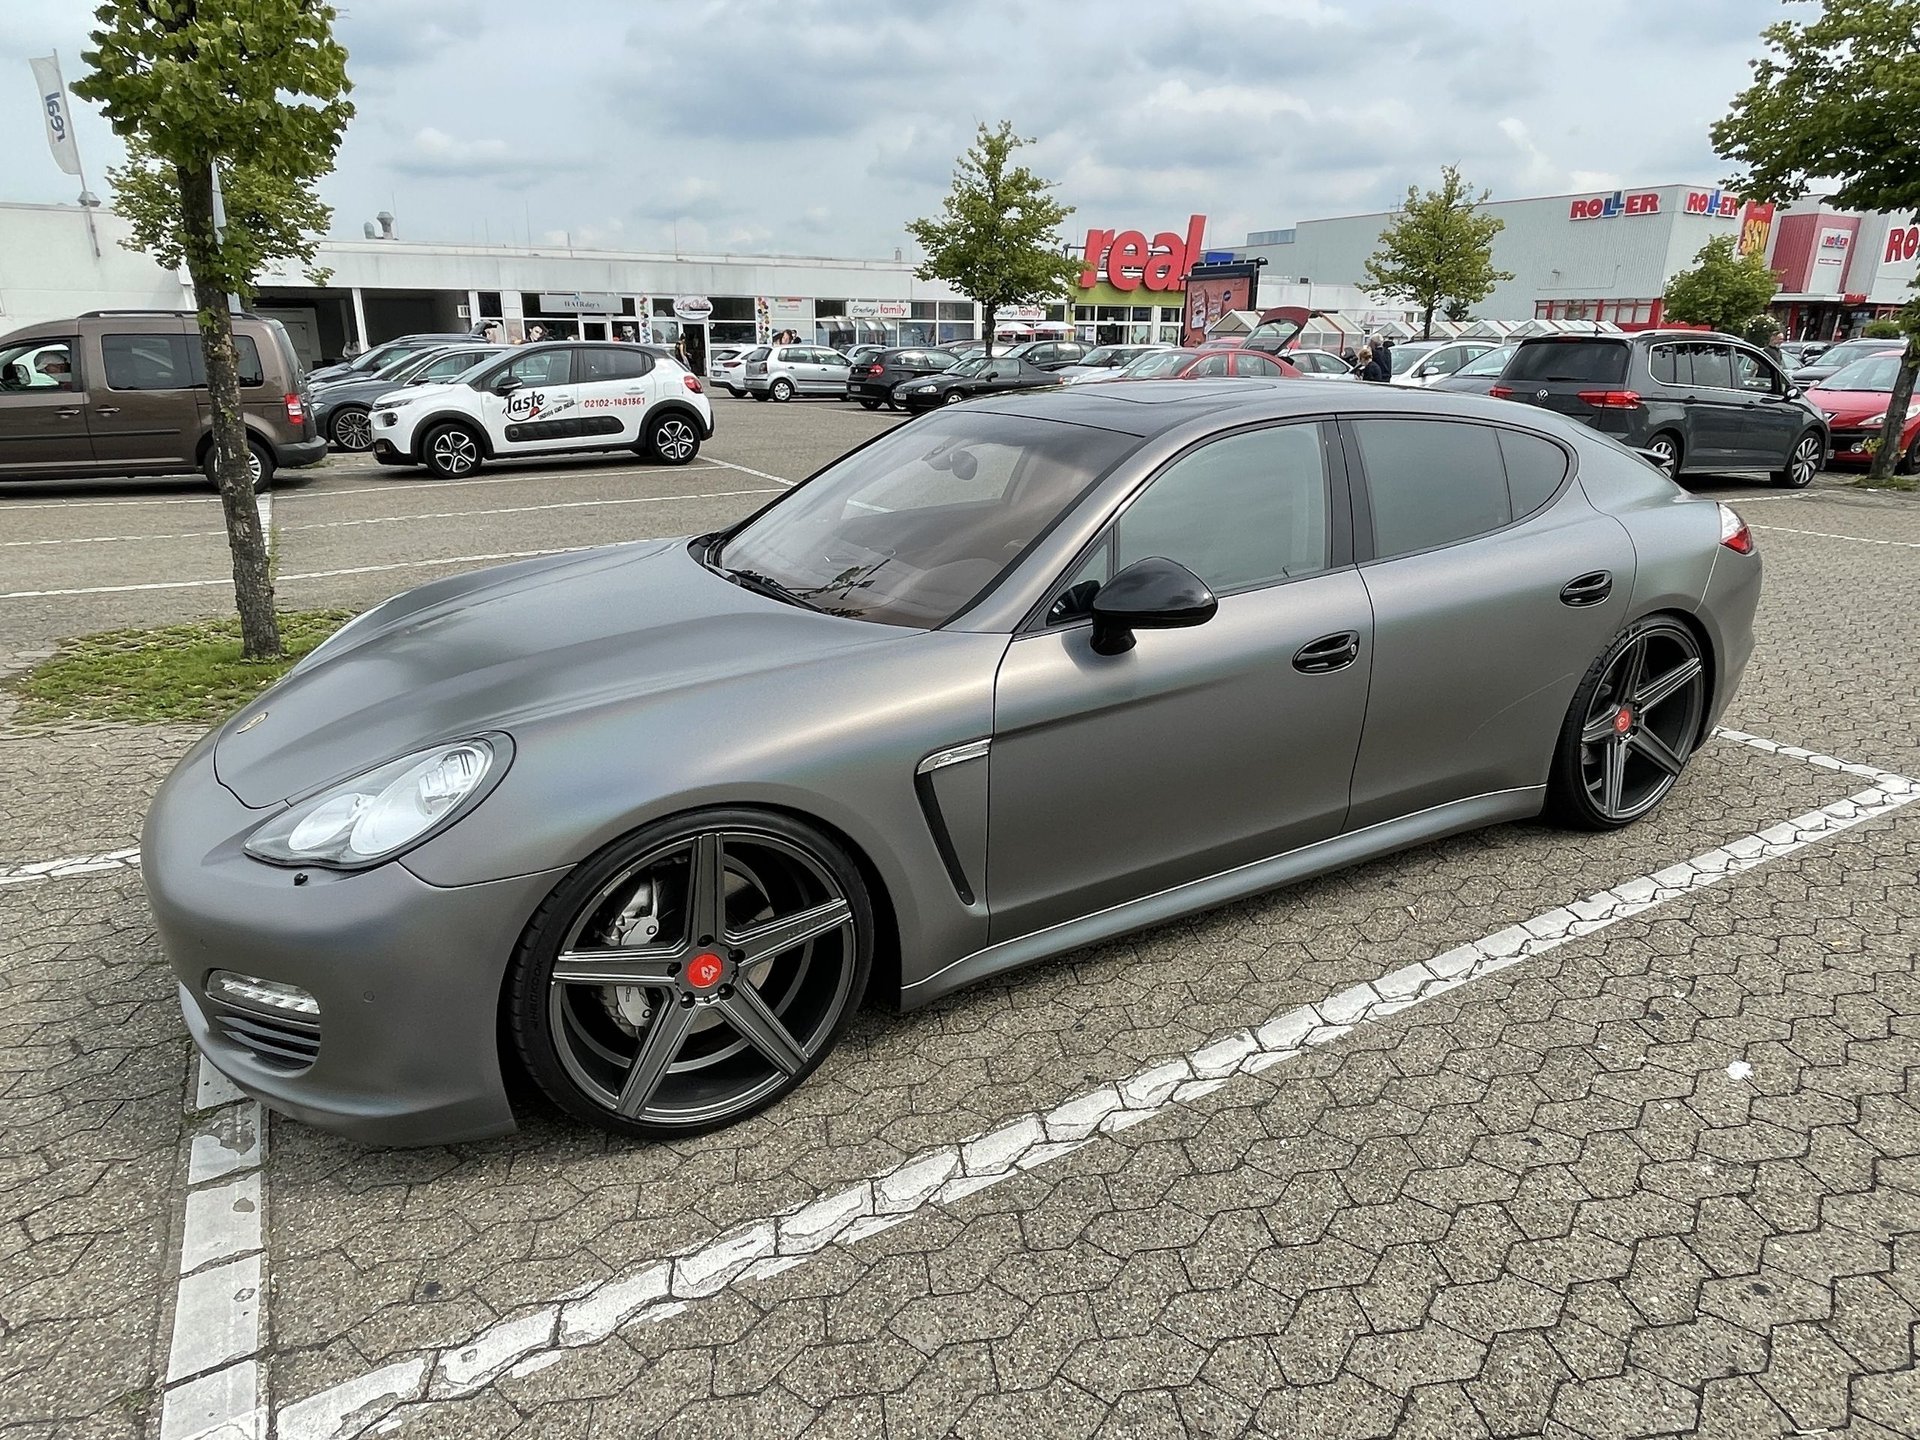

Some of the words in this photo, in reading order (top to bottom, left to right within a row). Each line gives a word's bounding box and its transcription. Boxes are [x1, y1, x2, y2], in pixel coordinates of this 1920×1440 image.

[1569, 191, 1660, 219] ROLLER
[1687, 189, 1739, 216] ROLLER
[1081, 214, 1206, 291] real
[1884, 227, 1920, 263] RO
[880, 304, 907, 316] family
[503, 391, 545, 414] Taste
